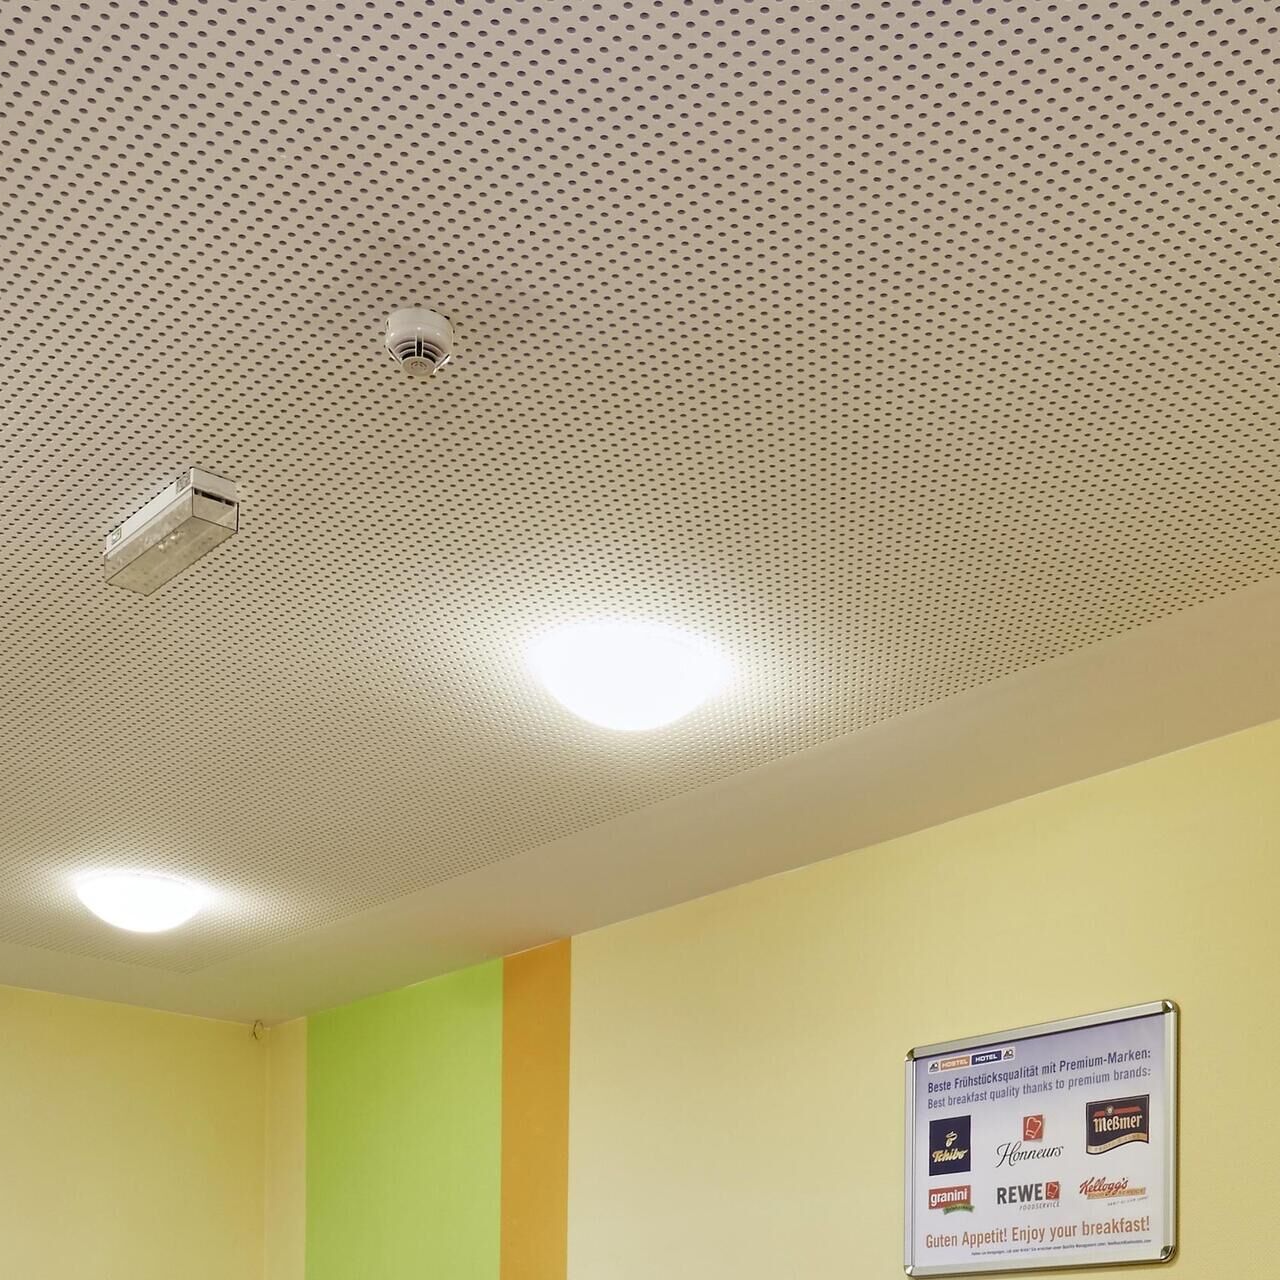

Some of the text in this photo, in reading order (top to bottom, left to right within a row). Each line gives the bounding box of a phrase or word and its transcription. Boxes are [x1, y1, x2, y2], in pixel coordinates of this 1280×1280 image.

[928, 1049, 1151, 1094] Beste Frühstücksqualität mit Premium-Marken:
[941, 1059, 968, 1068] HOSTEL
[975, 1053, 998, 1062] HOTEL
[928, 1066, 1151, 1109] Best breakfast quality thanks to premium brands:
[1093, 1113, 1143, 1133] Meßmer
[932, 1147, 968, 1163] Tchibo
[996, 1140, 1064, 1168] Honneurs
[930, 1187, 968, 1207] granini
[996, 1182, 1043, 1205] REWE
[1079, 1176, 1129, 1197] Kellogg's
[926, 1233, 958, 1249] Guten
[962, 1229, 1008, 1249] Appetit!
[1012, 1226, 1045, 1244] Enjoy
[1050, 1224, 1078, 1243] your
[1082, 1215, 1150, 1236] breakfast!
